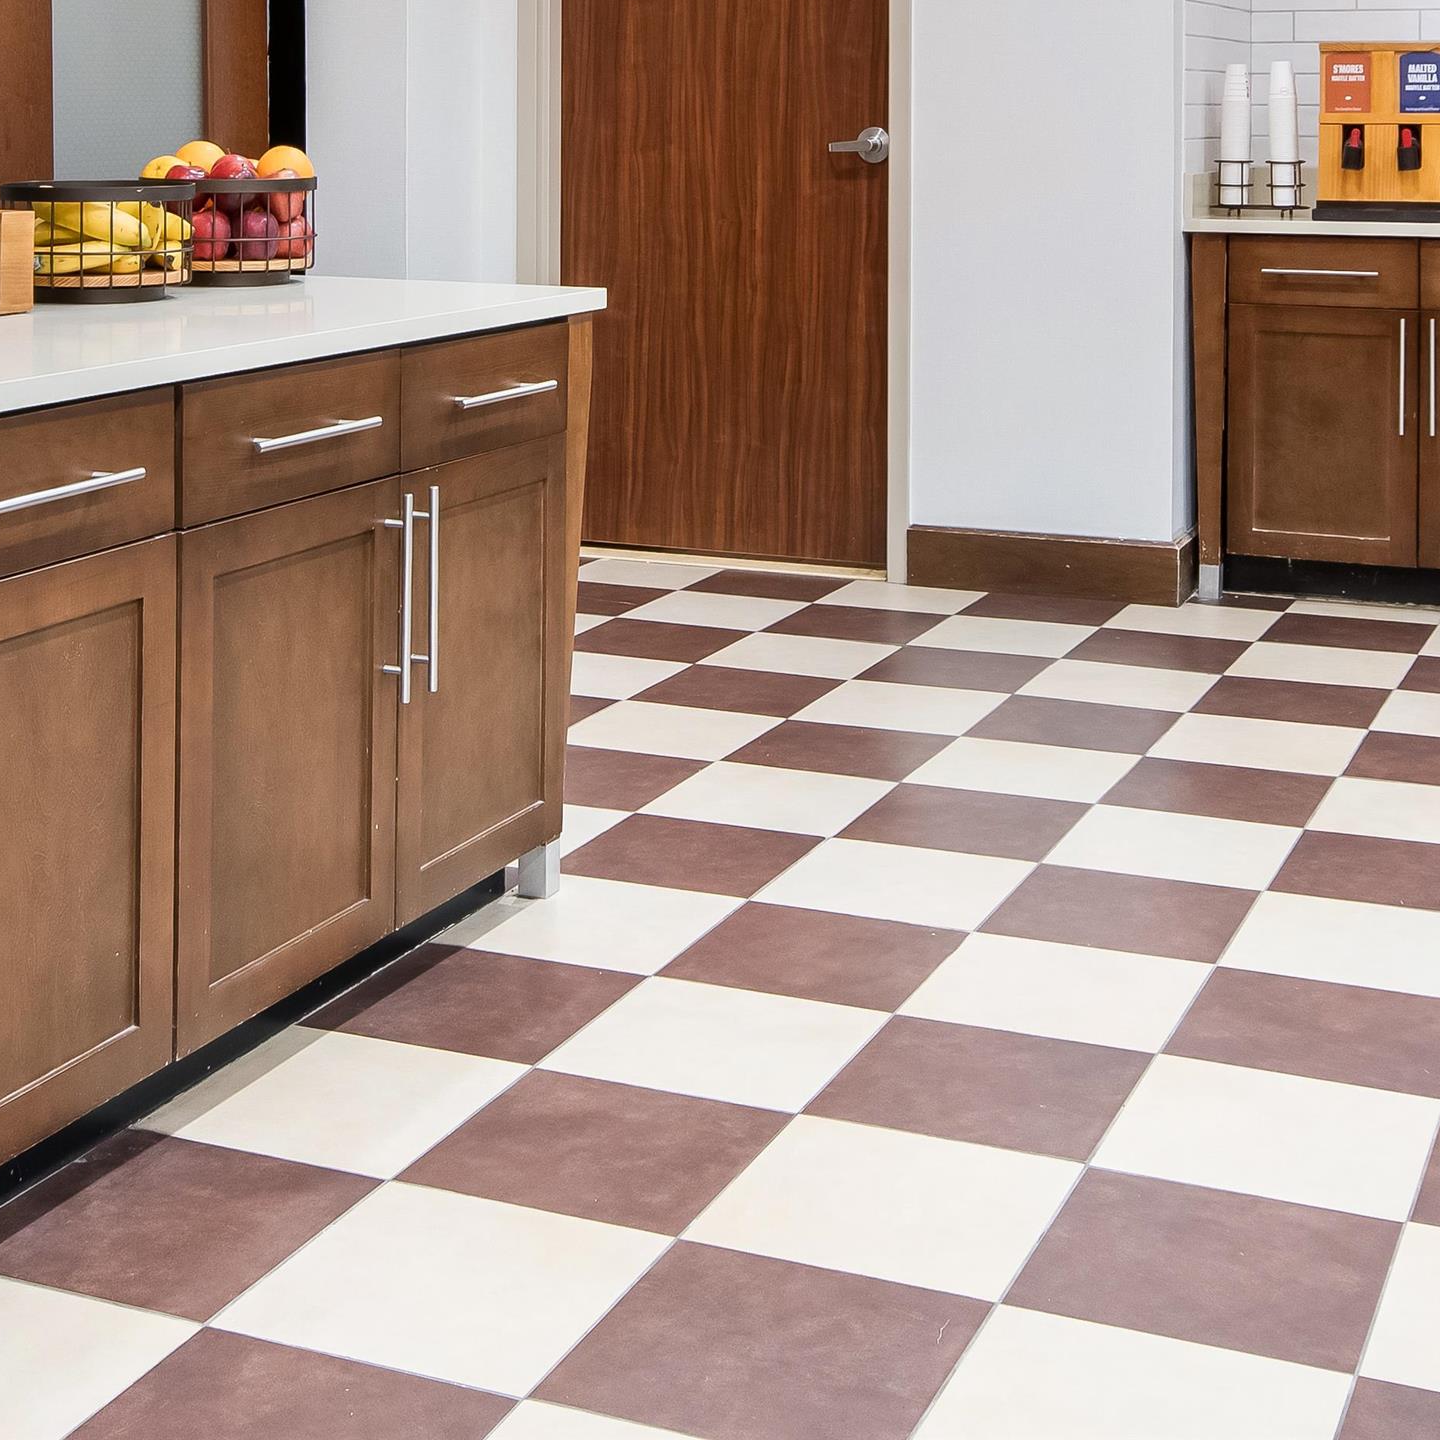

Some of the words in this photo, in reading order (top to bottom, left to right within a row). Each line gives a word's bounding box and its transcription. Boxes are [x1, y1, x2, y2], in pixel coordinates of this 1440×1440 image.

[1332, 63, 1364, 74] S'MORES
[1408, 63, 1437, 73] MALTED
[1407, 73, 1438, 83] VANILLA
